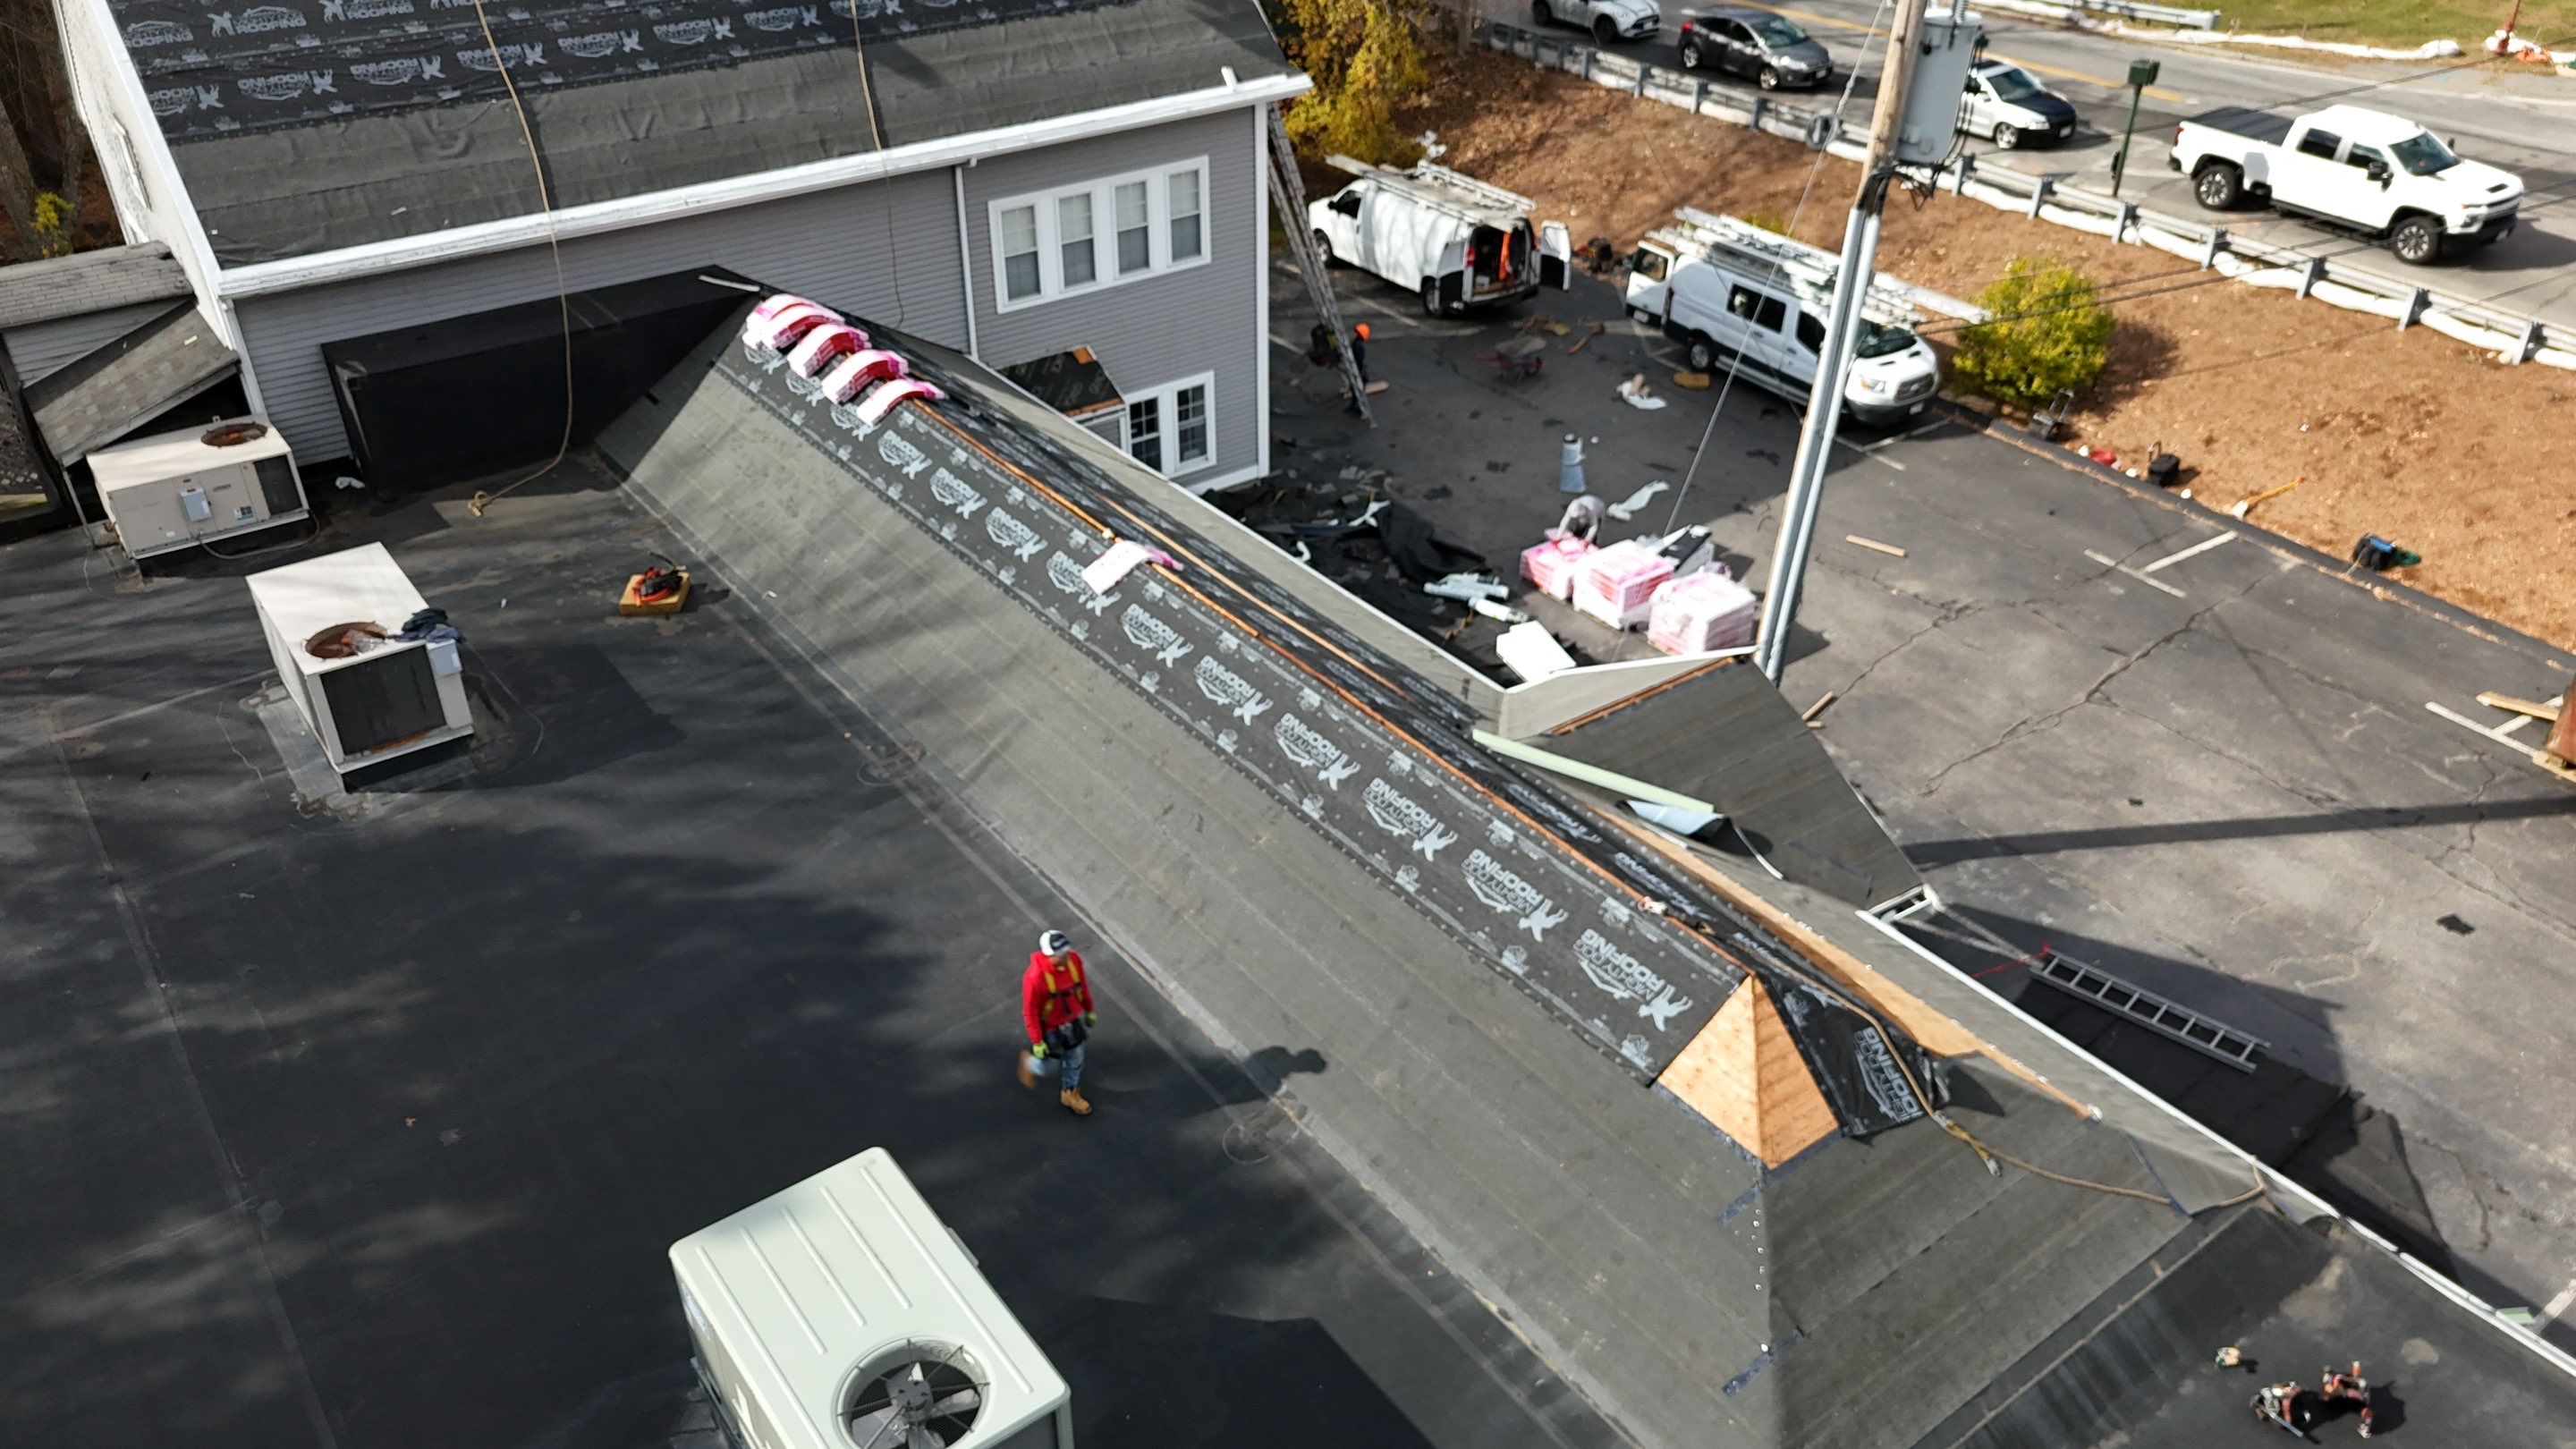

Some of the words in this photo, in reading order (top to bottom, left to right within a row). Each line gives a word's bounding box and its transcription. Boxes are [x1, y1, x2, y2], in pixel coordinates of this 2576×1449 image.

[235, 70, 308, 89] ROOFING
[1125, 601, 1180, 642] ROOFING
[1199, 652, 1258, 699] ROOFING
[1278, 710, 1343, 760] ROOFING
[1367, 775, 1438, 830] ROOFING
[1459, 857, 1492, 884] DOG
[1467, 846, 1545, 906] ROOFING
[1485, 876, 1535, 915] MIGHTY
[1571, 936, 1607, 966] DOG
[1578, 926, 1667, 992] ROOFING
[1600, 958, 1657, 1002] MIGHTY
